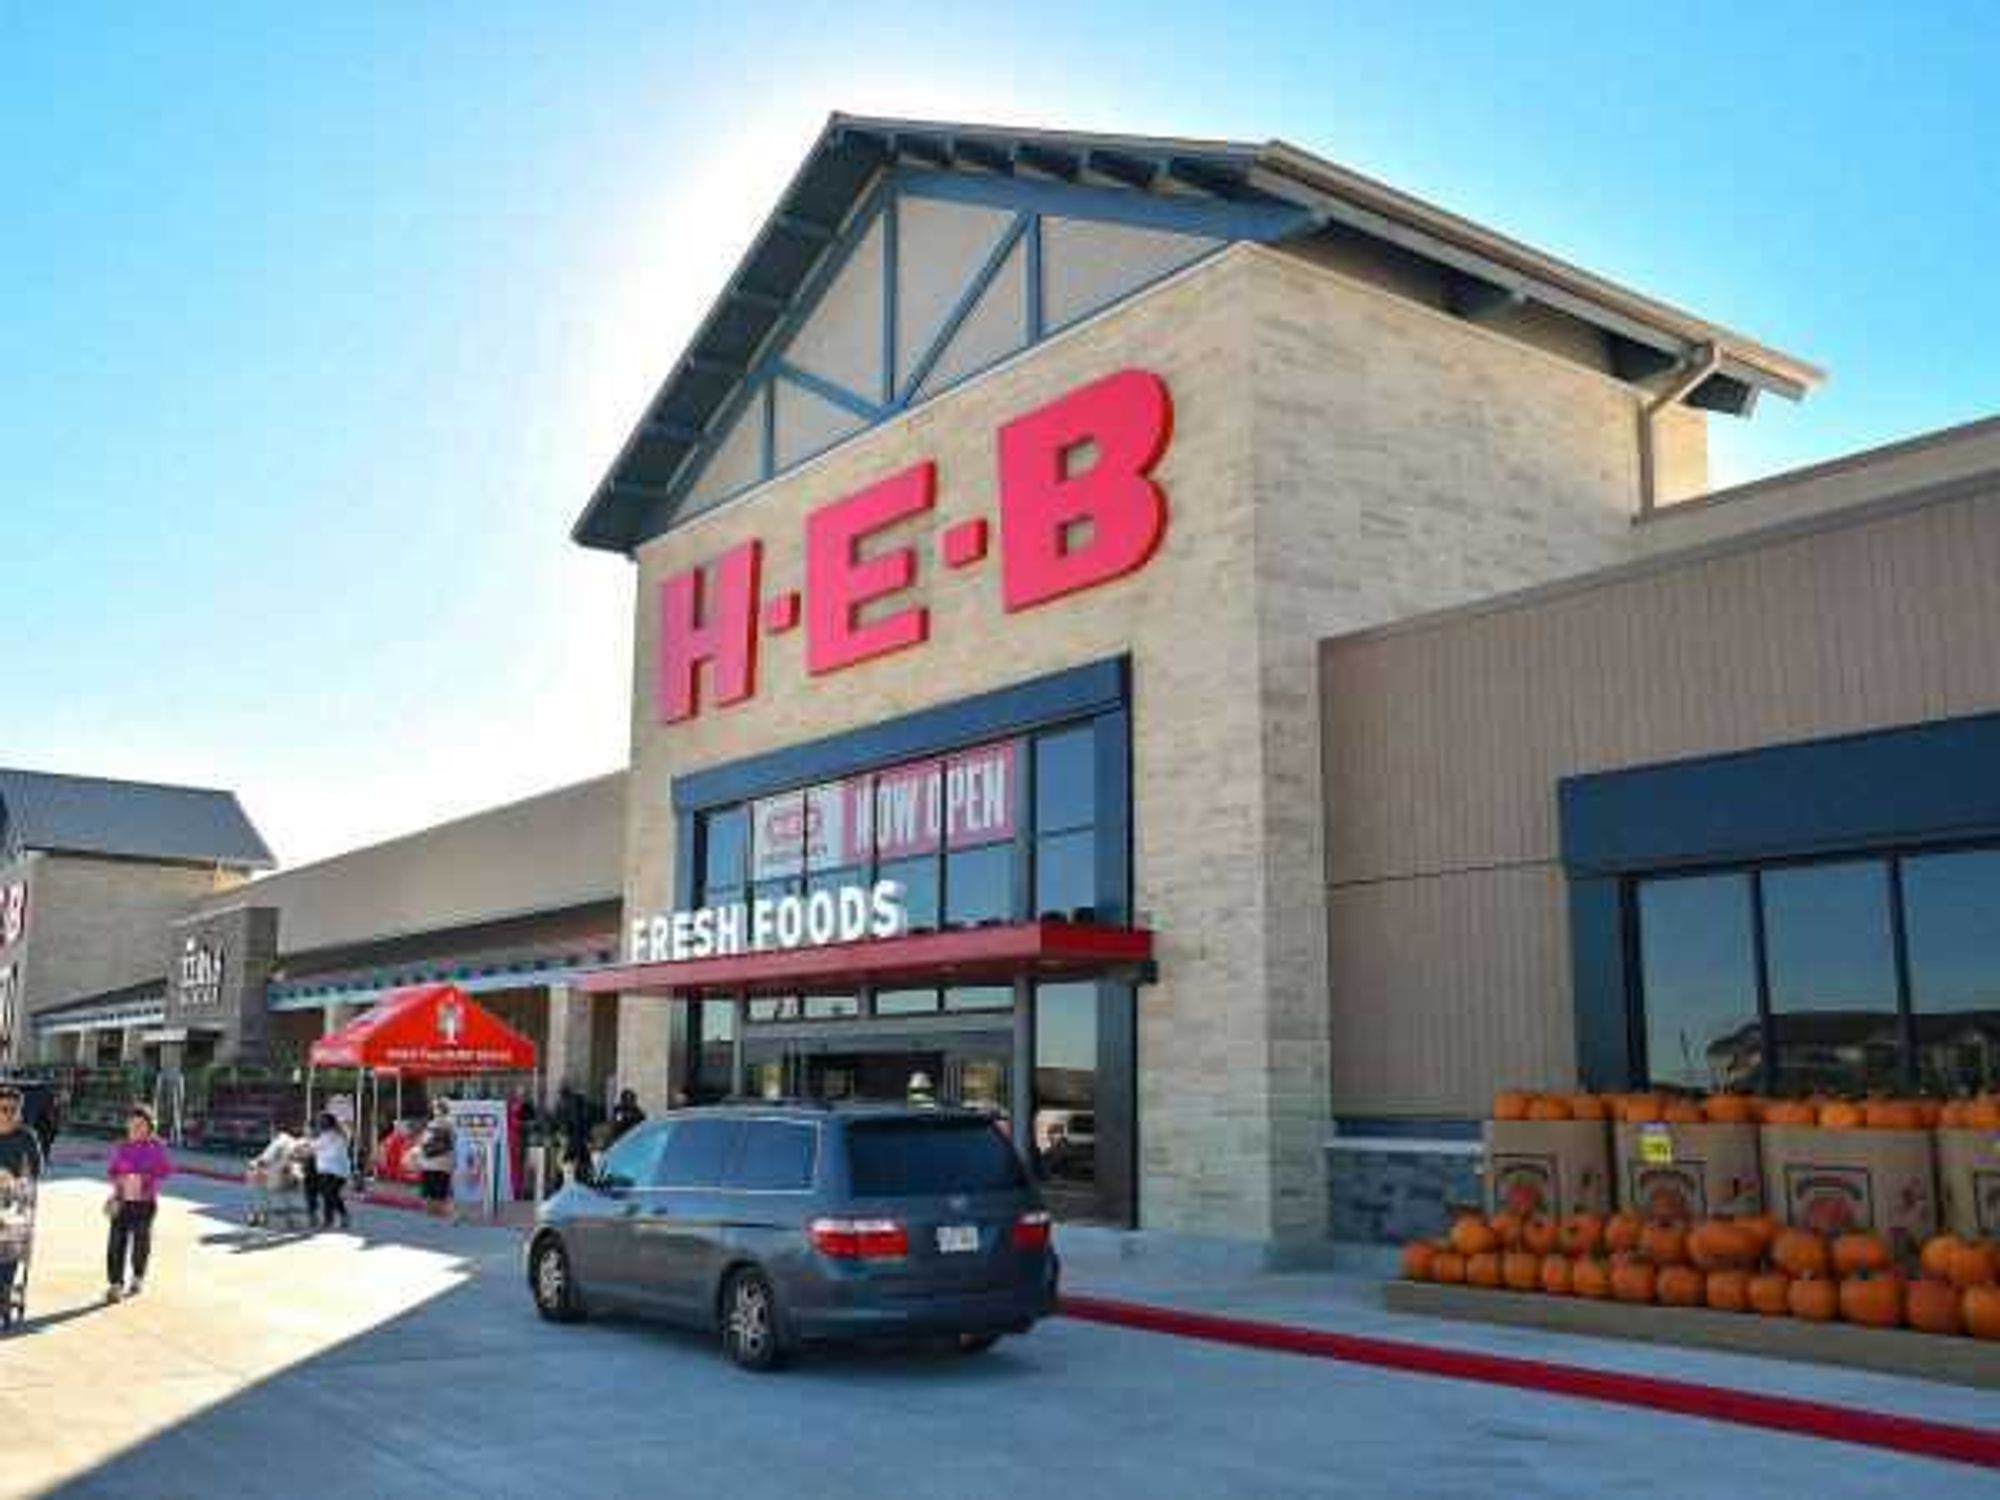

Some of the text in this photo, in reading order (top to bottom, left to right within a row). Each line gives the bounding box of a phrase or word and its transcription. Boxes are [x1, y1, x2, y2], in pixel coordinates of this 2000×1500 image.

[658, 367, 1174, 724] H-E-B
[855, 757, 1005, 853] NOW OPEN
[630, 879, 905, 962] FRESH FOODS
